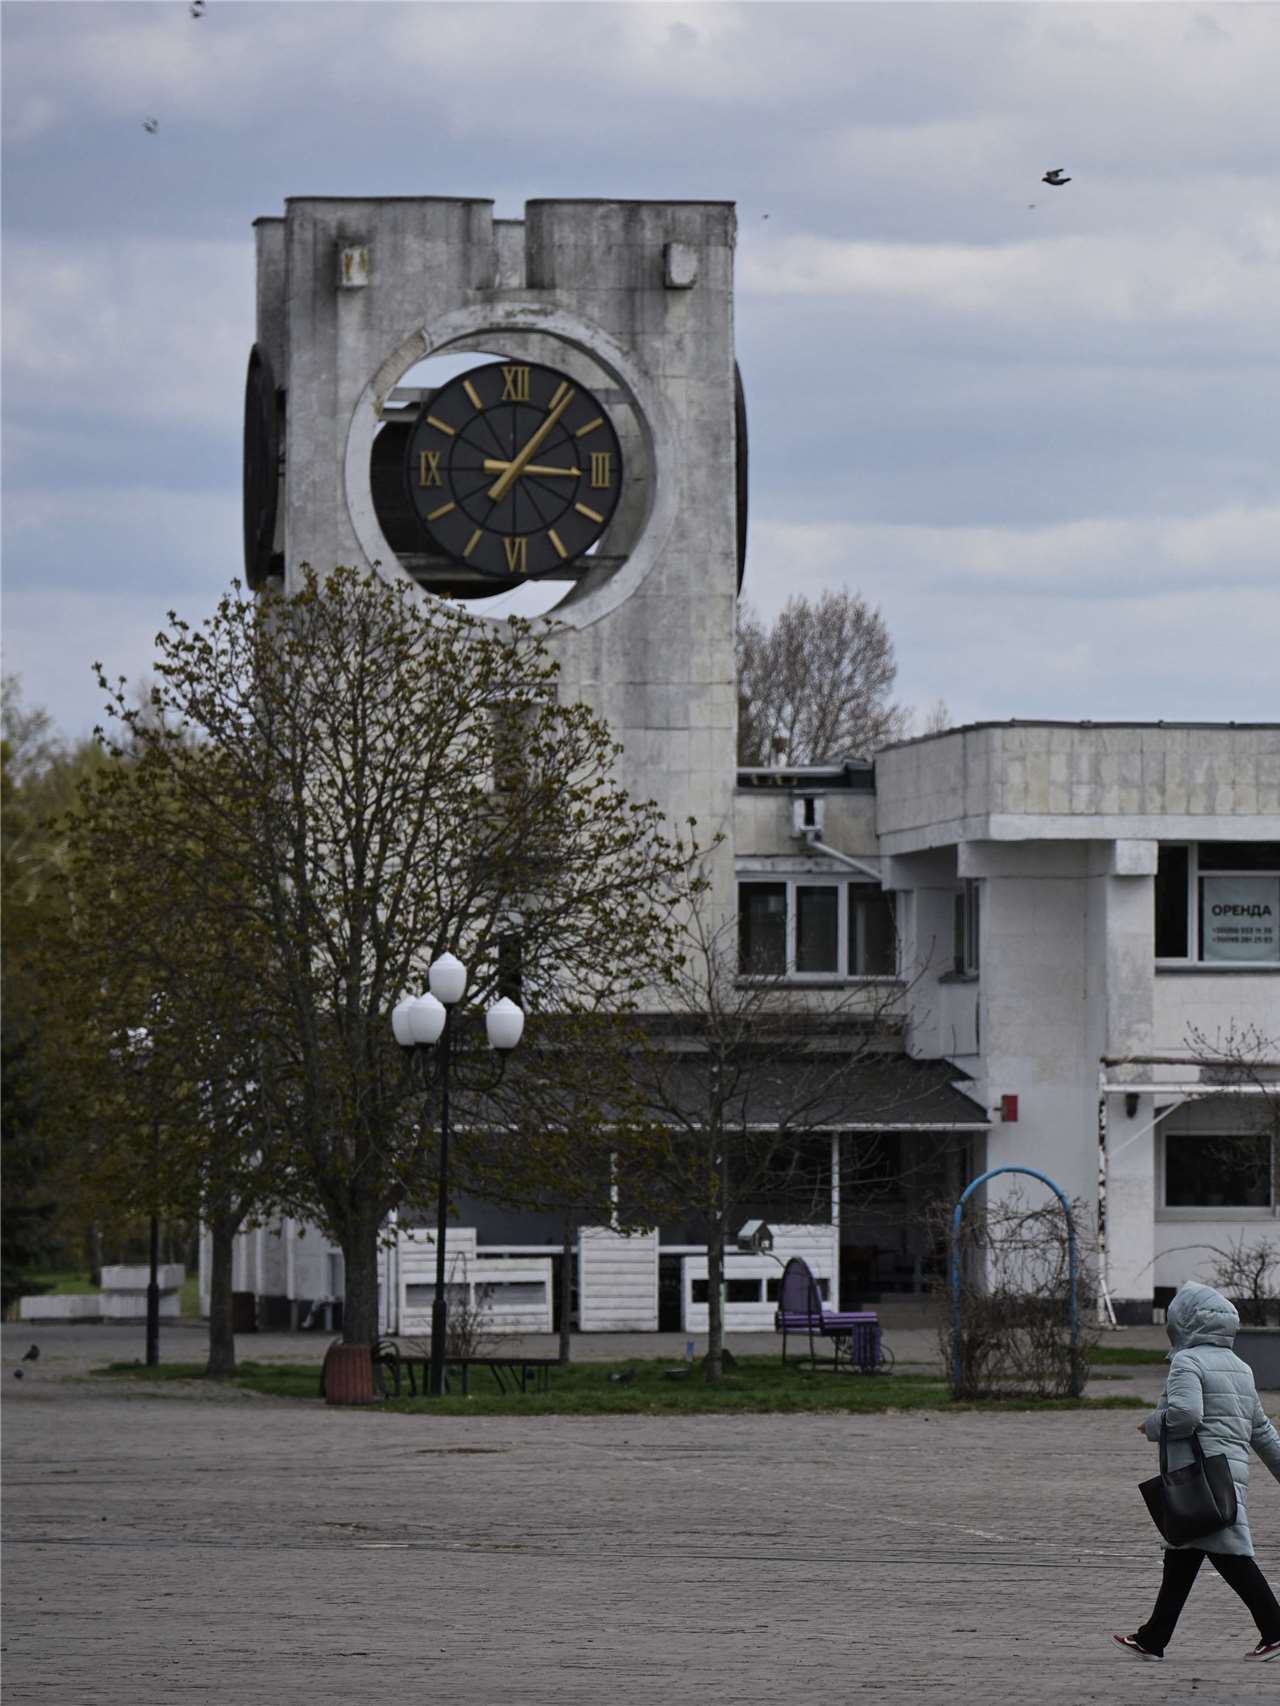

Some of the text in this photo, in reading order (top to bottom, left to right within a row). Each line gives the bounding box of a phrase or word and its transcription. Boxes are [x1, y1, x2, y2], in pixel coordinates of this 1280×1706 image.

[502, 366, 530, 401] XII
[420, 451, 443, 487] IX
[591, 452, 611, 488] III
[503, 537, 528, 573] VI
[1211, 904, 1272, 918] ОРЕНДА
